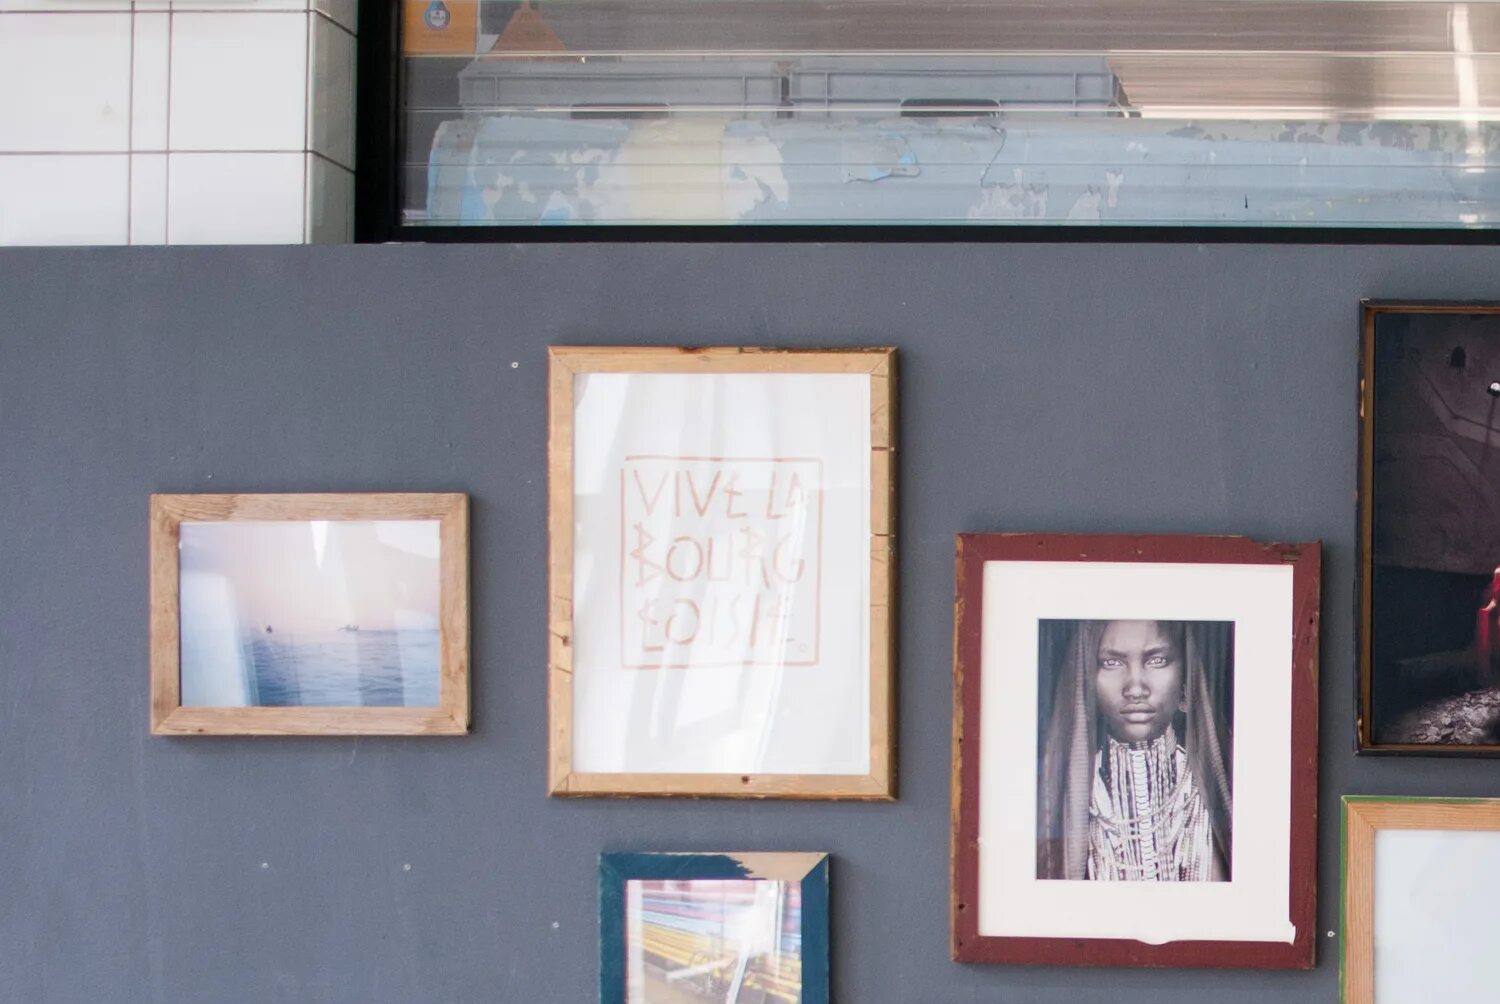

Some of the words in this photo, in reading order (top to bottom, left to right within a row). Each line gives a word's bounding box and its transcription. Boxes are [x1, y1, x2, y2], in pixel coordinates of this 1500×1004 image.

[633, 469, 748, 519] VIVE
[766, 471, 806, 520] LA
[629, 522, 806, 589] BOURG
